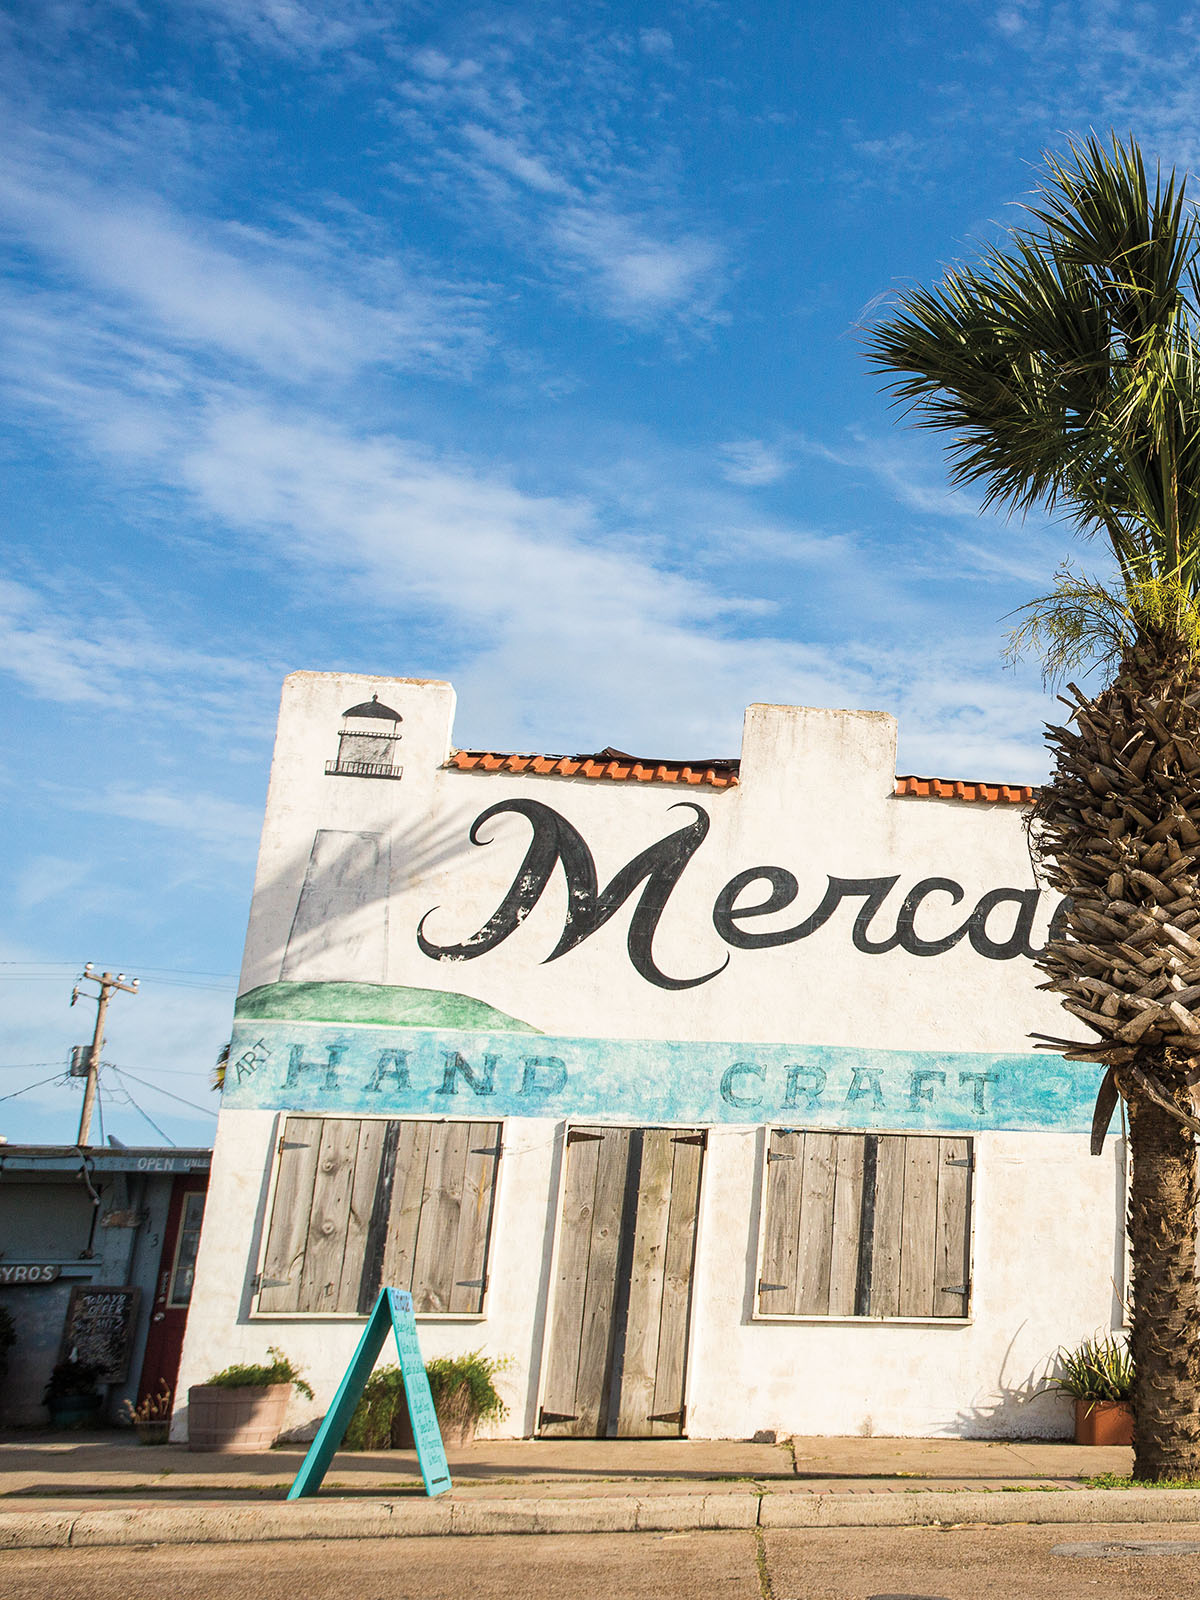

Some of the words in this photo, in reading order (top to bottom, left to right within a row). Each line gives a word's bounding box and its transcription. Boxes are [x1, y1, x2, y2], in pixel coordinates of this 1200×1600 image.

[417, 798, 1075, 991] Merca
[233, 1037, 275, 1085] ART
[280, 1043, 569, 1098] HAND
[719, 1061, 1000, 1116] CRAFT
[137, 1157, 176, 1171] OPEN
[0, 1265, 55, 1281] YROS
